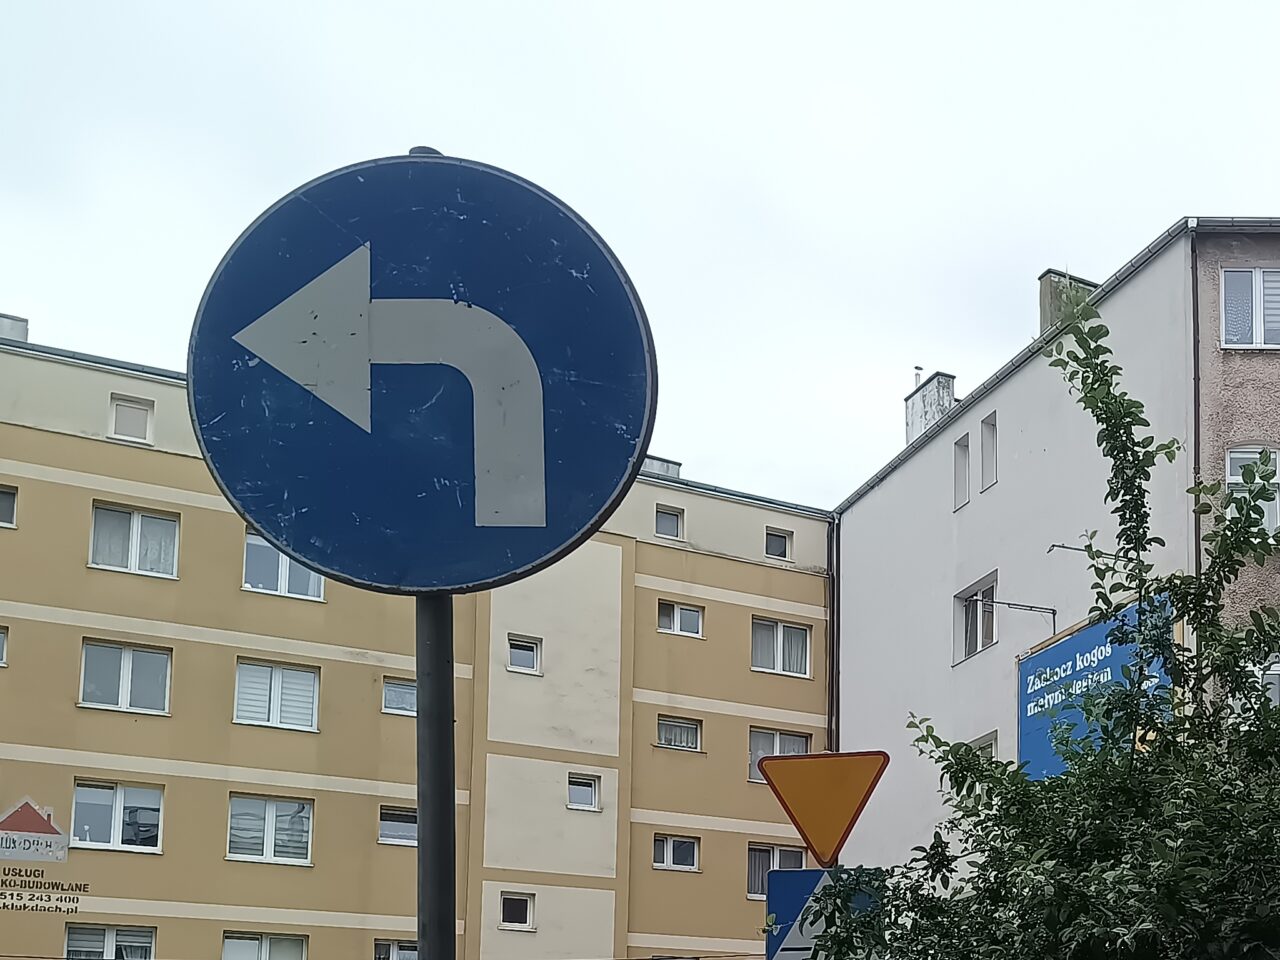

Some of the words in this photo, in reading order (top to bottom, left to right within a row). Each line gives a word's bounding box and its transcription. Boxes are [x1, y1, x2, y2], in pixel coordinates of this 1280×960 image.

[1075, 636, 1112, 672] kogoś
[2, 867, 45, 879] USŁUGI
[0, 891, 24, 901] 515
[27, 893, 52, 903] 243
[55, 894, 80, 904] 400
